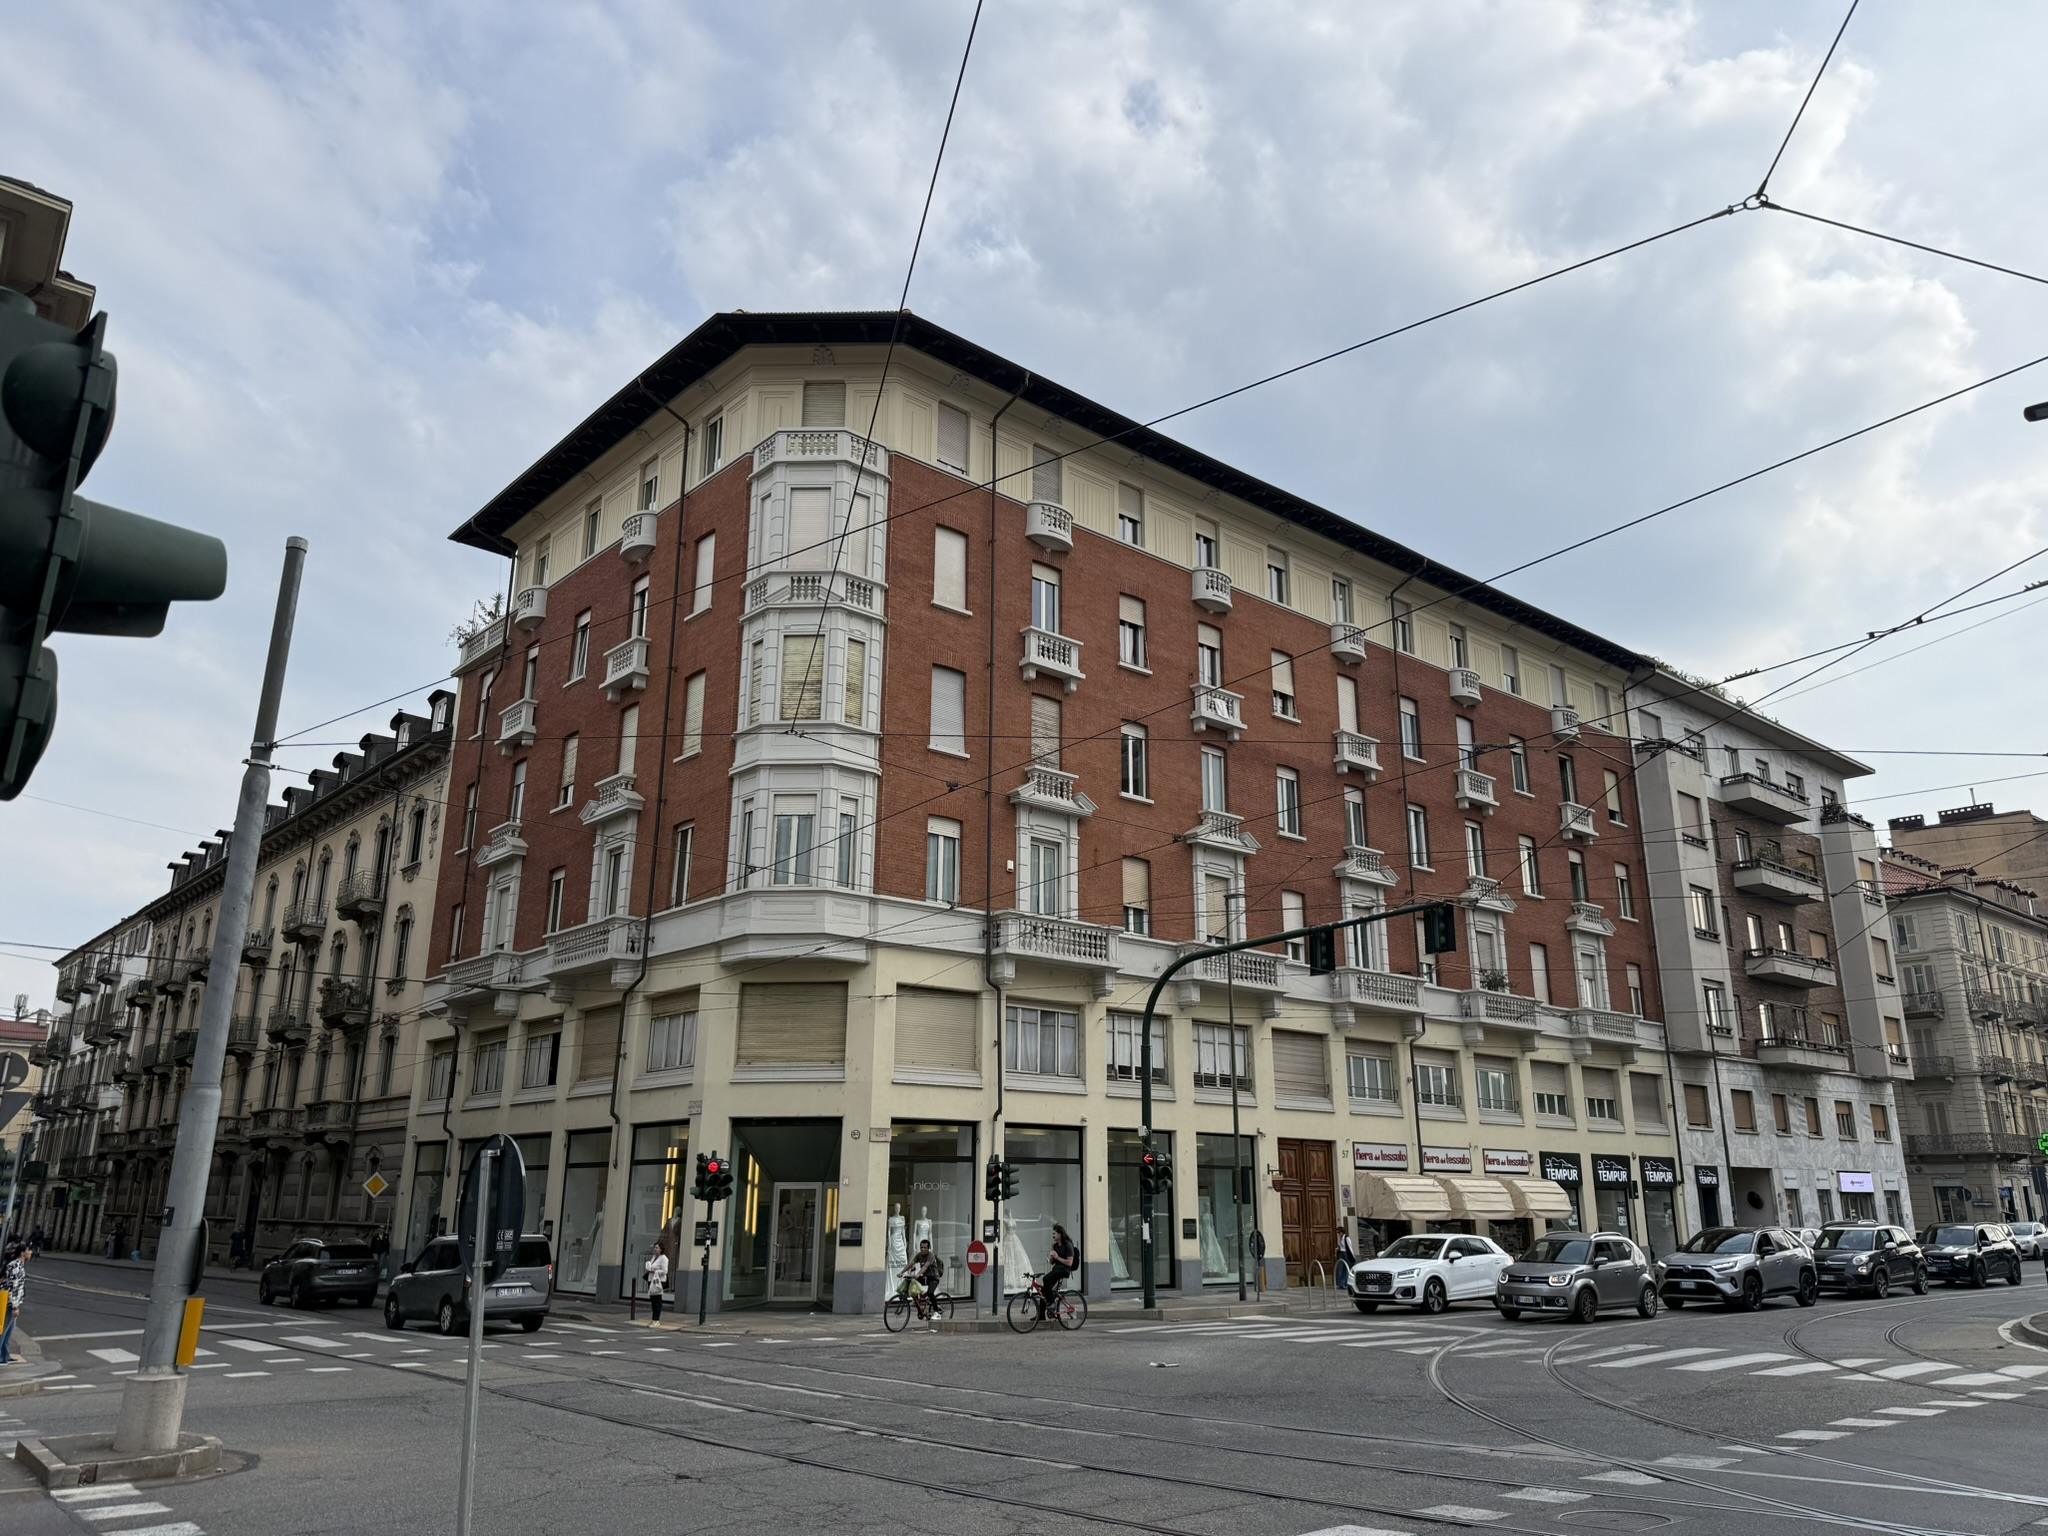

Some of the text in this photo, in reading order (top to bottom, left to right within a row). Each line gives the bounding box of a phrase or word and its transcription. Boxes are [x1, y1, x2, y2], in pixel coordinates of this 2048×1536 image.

[1342, 1149, 1349, 1158] 57
[1355, 1148, 1373, 1160] fiera
[1423, 1152, 1439, 1164] fiera
[1485, 1154, 1500, 1166] fiera
[1546, 1168, 1578, 1180] TEMPUR
[1598, 1170, 1628, 1182] TEMPUR
[1645, 1170, 1674, 1183] TEMPUR
[913, 1181, 950, 1191] nicole
[1699, 1176, 1717, 1185] TEMPUR
